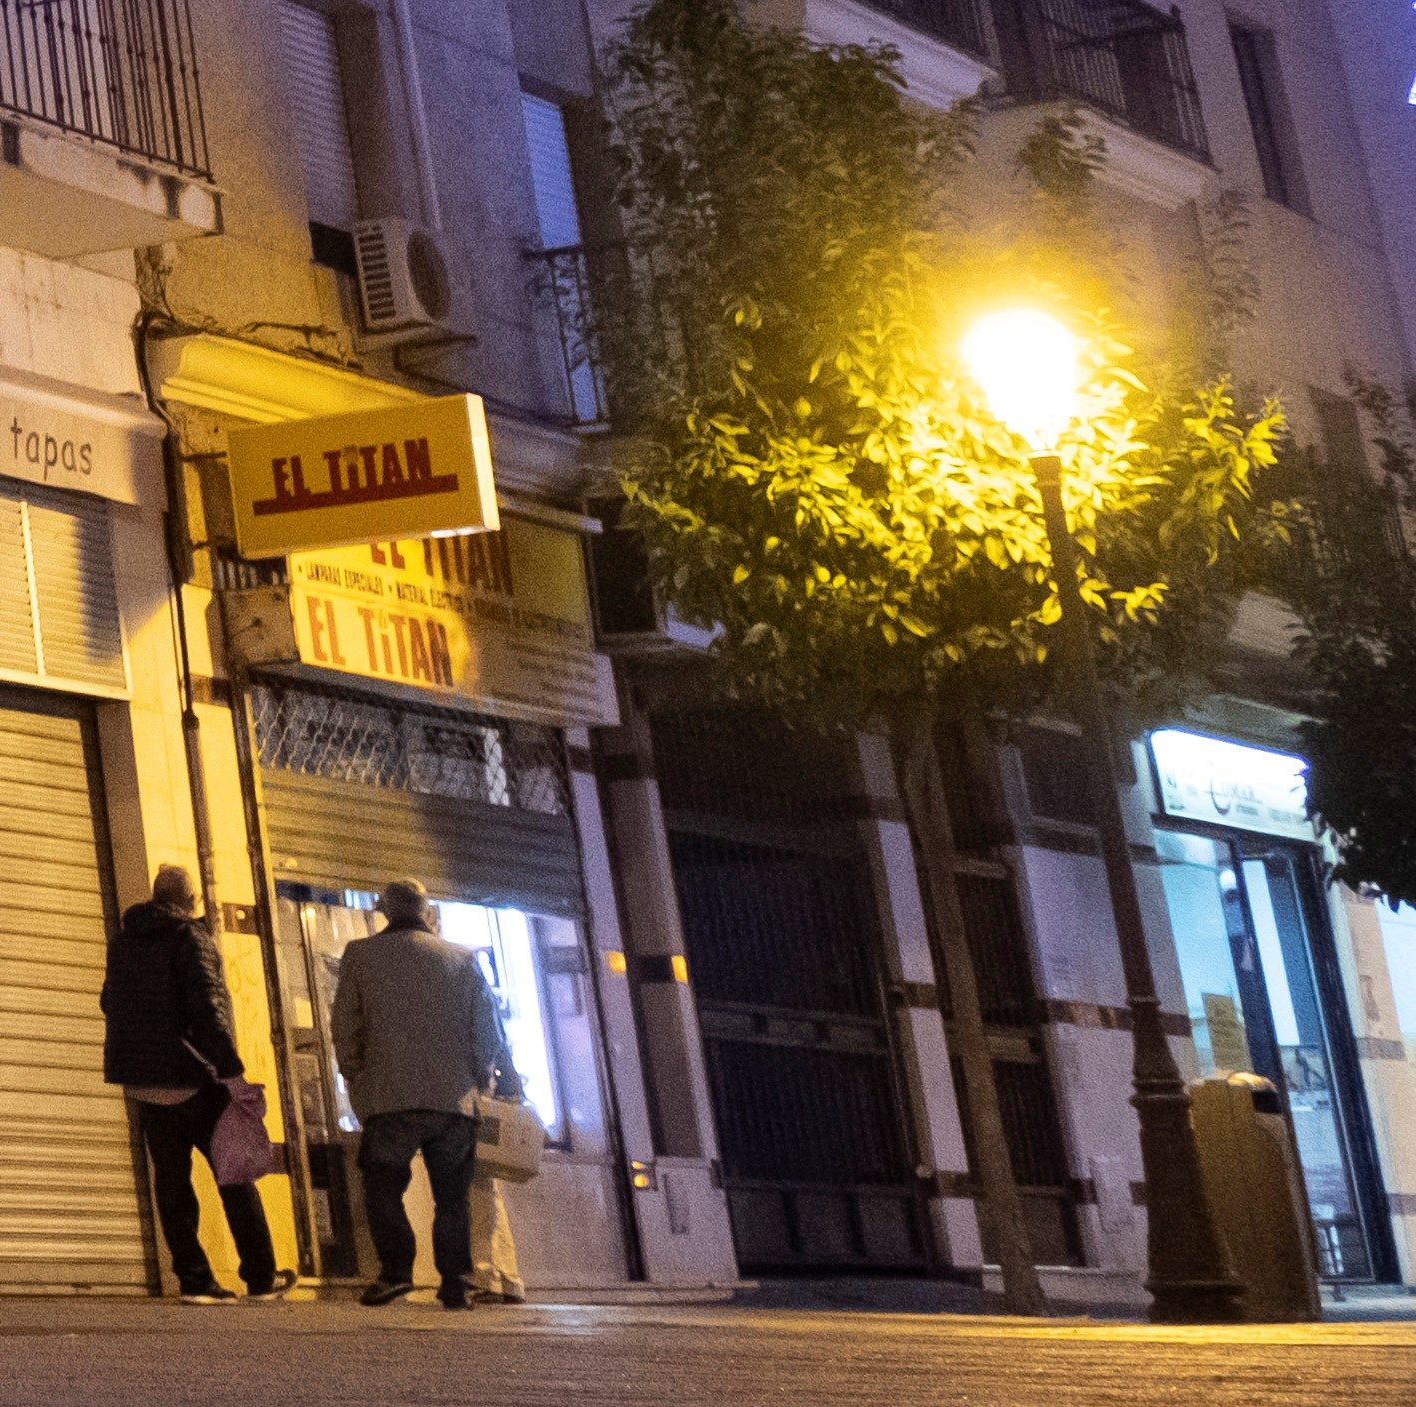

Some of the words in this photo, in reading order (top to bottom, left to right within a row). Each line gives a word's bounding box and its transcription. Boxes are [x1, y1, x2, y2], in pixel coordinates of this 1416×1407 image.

[11, 416, 93, 483] tapas
[271, 455, 311, 498] EL
[306, 595, 346, 666] EL
